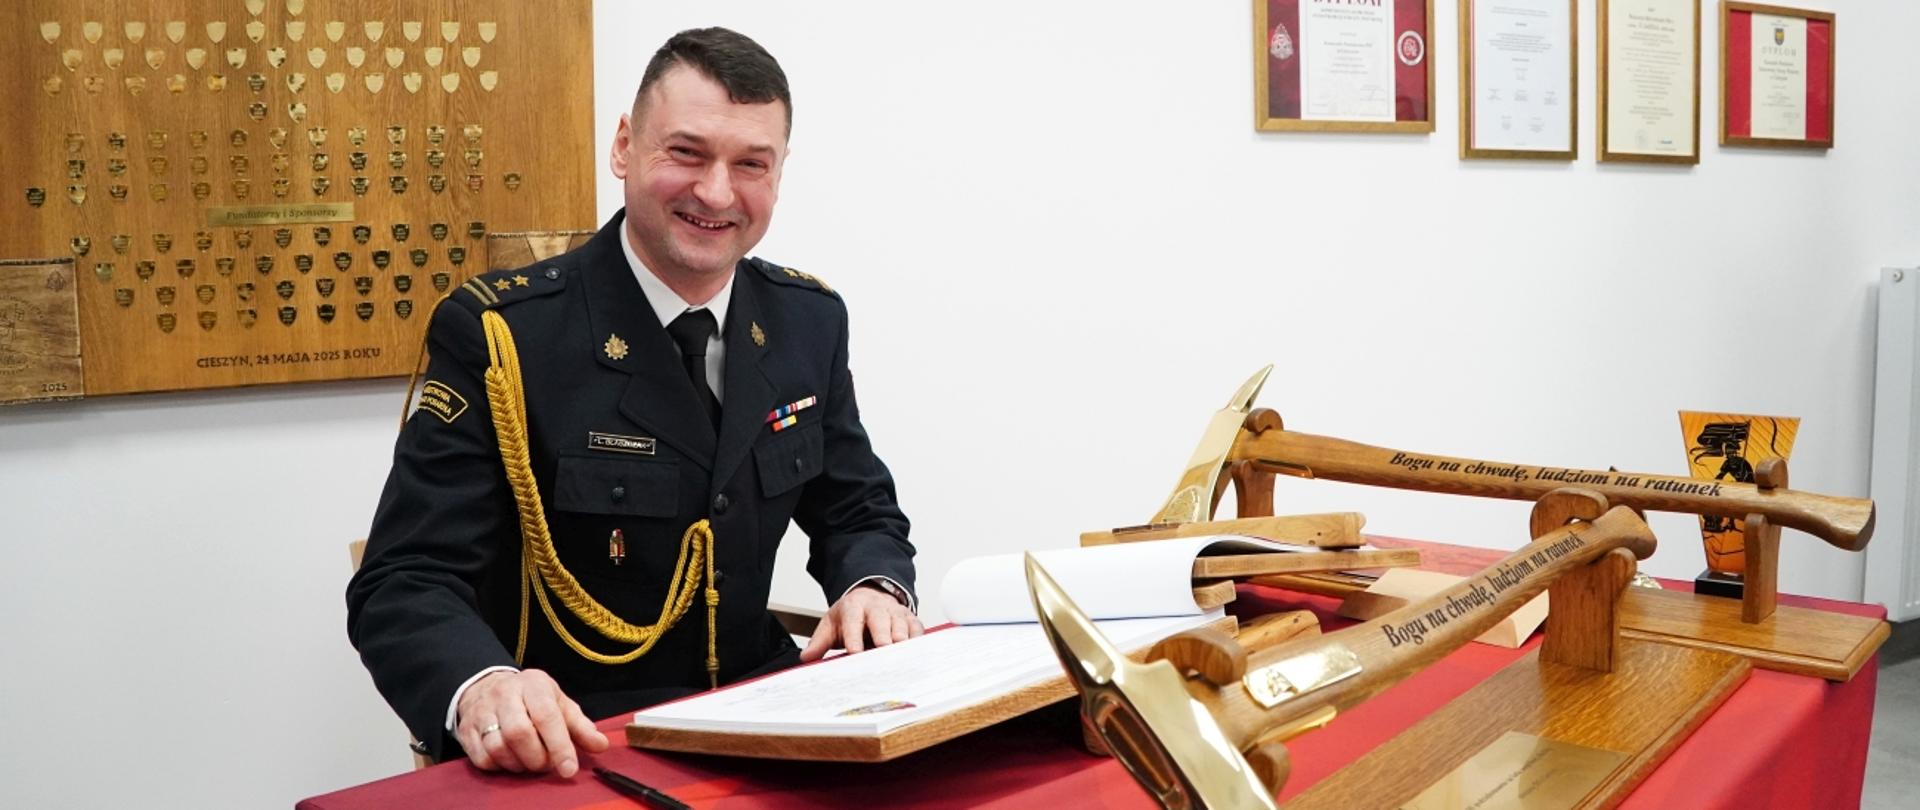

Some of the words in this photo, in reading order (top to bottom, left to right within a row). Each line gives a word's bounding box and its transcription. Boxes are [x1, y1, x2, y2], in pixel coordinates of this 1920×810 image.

[289, 207, 338, 218] Sponsorzy
[196, 355, 254, 368] CIESZYN,
[256, 354, 270, 365] 24
[273, 352, 310, 364] MAJA
[313, 350, 341, 362] 2025
[343, 347, 381, 360] ROKU
[41, 382, 67, 393] 2025
[1389, 452, 1433, 471] Bogu
[1437, 462, 1459, 473] na
[1464, 461, 1529, 482] chwałę,
[1535, 467, 1609, 485] ludziom
[1615, 474, 1640, 488] na
[1644, 477, 1723, 498] ratunek
[1381, 616, 1429, 648] Bogu
[1426, 608, 1447, 629] na
[1446, 583, 1497, 619] chwałę,
[1484, 559, 1534, 594] ludziom
[1530, 551, 1548, 570] na
[1544, 530, 1585, 563] ratunek
